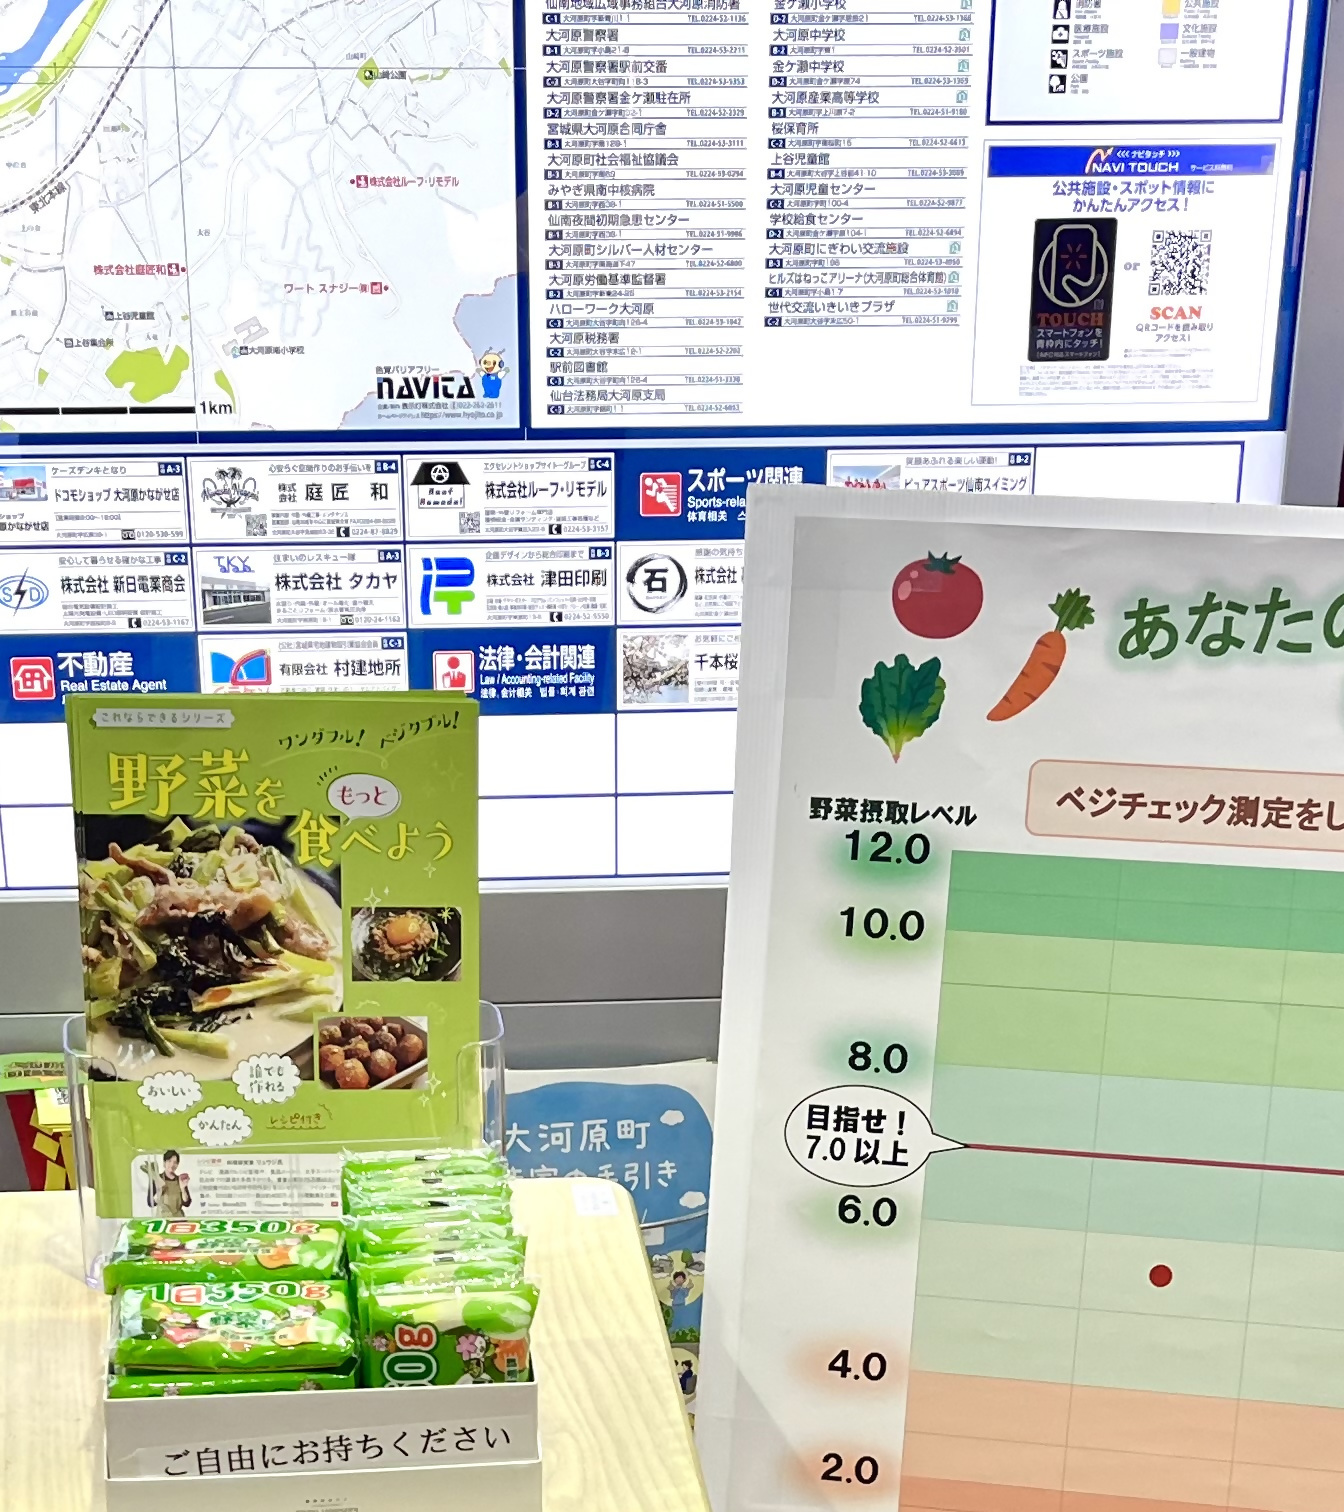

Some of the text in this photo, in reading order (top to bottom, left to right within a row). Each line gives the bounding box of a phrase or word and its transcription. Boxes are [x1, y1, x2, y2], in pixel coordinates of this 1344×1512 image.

[546, 29, 618, 42] 大河原警察署
[773, 29, 845, 42] 大河原中学校
[546, 60, 667, 73] 大河原警察署駅前交番
[772, 91, 879, 104] 大河原産業高等学校
[772, 123, 818, 135] 桜保育所
[548, 154, 678, 166] 大河原町社会福祉協議会
[771, 154, 830, 166] 上谷児童館
[1092, 163, 1178, 172] NAVI TOUCH
[548, 185, 655, 196] みやぎ県南中核病院
[771, 183, 875, 196] 大河原児童センター
[1053, 180, 1214, 197] 公共施設・スポット情報に
[548, 214, 689, 226] 仙南夜間初期急患センター
[770, 214, 863, 226] 学校給食センター
[549, 244, 713, 256] 大河原町シルバー人材センター
[549, 274, 666, 286] 大河原労働基準監督署
[550, 303, 654, 315] ハローワーク大河原
[768, 301, 895, 313] 世代交流いきいきプラザ
[1150, 306, 1202, 320] SCAN
[1036, 313, 1104, 327] TOUCH
[550, 333, 619, 344] 大河原税務署
[1037, 328, 1102, 337] スマートフォンを
[550, 390, 665, 402] 仙台法務局大河原支局
[200, 401, 232, 415] 1km
[53, 489, 111, 503] ドコモショップ
[275, 573, 397, 591] 株式会社 タカヤ
[487, 569, 607, 587] 株式会社 津田印刷
[644, 569, 668, 593] 石
[694, 567, 737, 584] 株式会社
[60, 577, 109, 594] 株式会社
[58, 652, 134, 677] 不動産
[478, 644, 596, 671] 法律・会計関連
[279, 659, 402, 677] 有限会社 村建地所
[60, 678, 167, 692] Real Estate Agent
[479, 672, 596, 685] Law Accounting-related Facility
[101, 712, 226, 724] これならできるシリーズ
[109, 748, 285, 820] 野菜を
[337, 785, 388, 806] もっと
[809, 796, 977, 829] 野菜摂取レベル
[290, 809, 453, 868] 食べよう
[844, 830, 931, 866] 12.0
[839, 906, 926, 942] 10.0
[847, 1040, 908, 1074] 8.0
[148, 1083, 192, 1099] おいしい
[250, 1078, 285, 1094] 作れる
[198, 1117, 242, 1132] かんたん
[806, 1103, 907, 1136] 目指せ！
[506, 1119, 650, 1153] 大河原町
[837, 1194, 897, 1227] 6.0
[827, 1349, 887, 1381] 4.0
[164, 1426, 511, 1477] ご自由にお持ちください
[820, 1453, 879, 1484] 2.0
